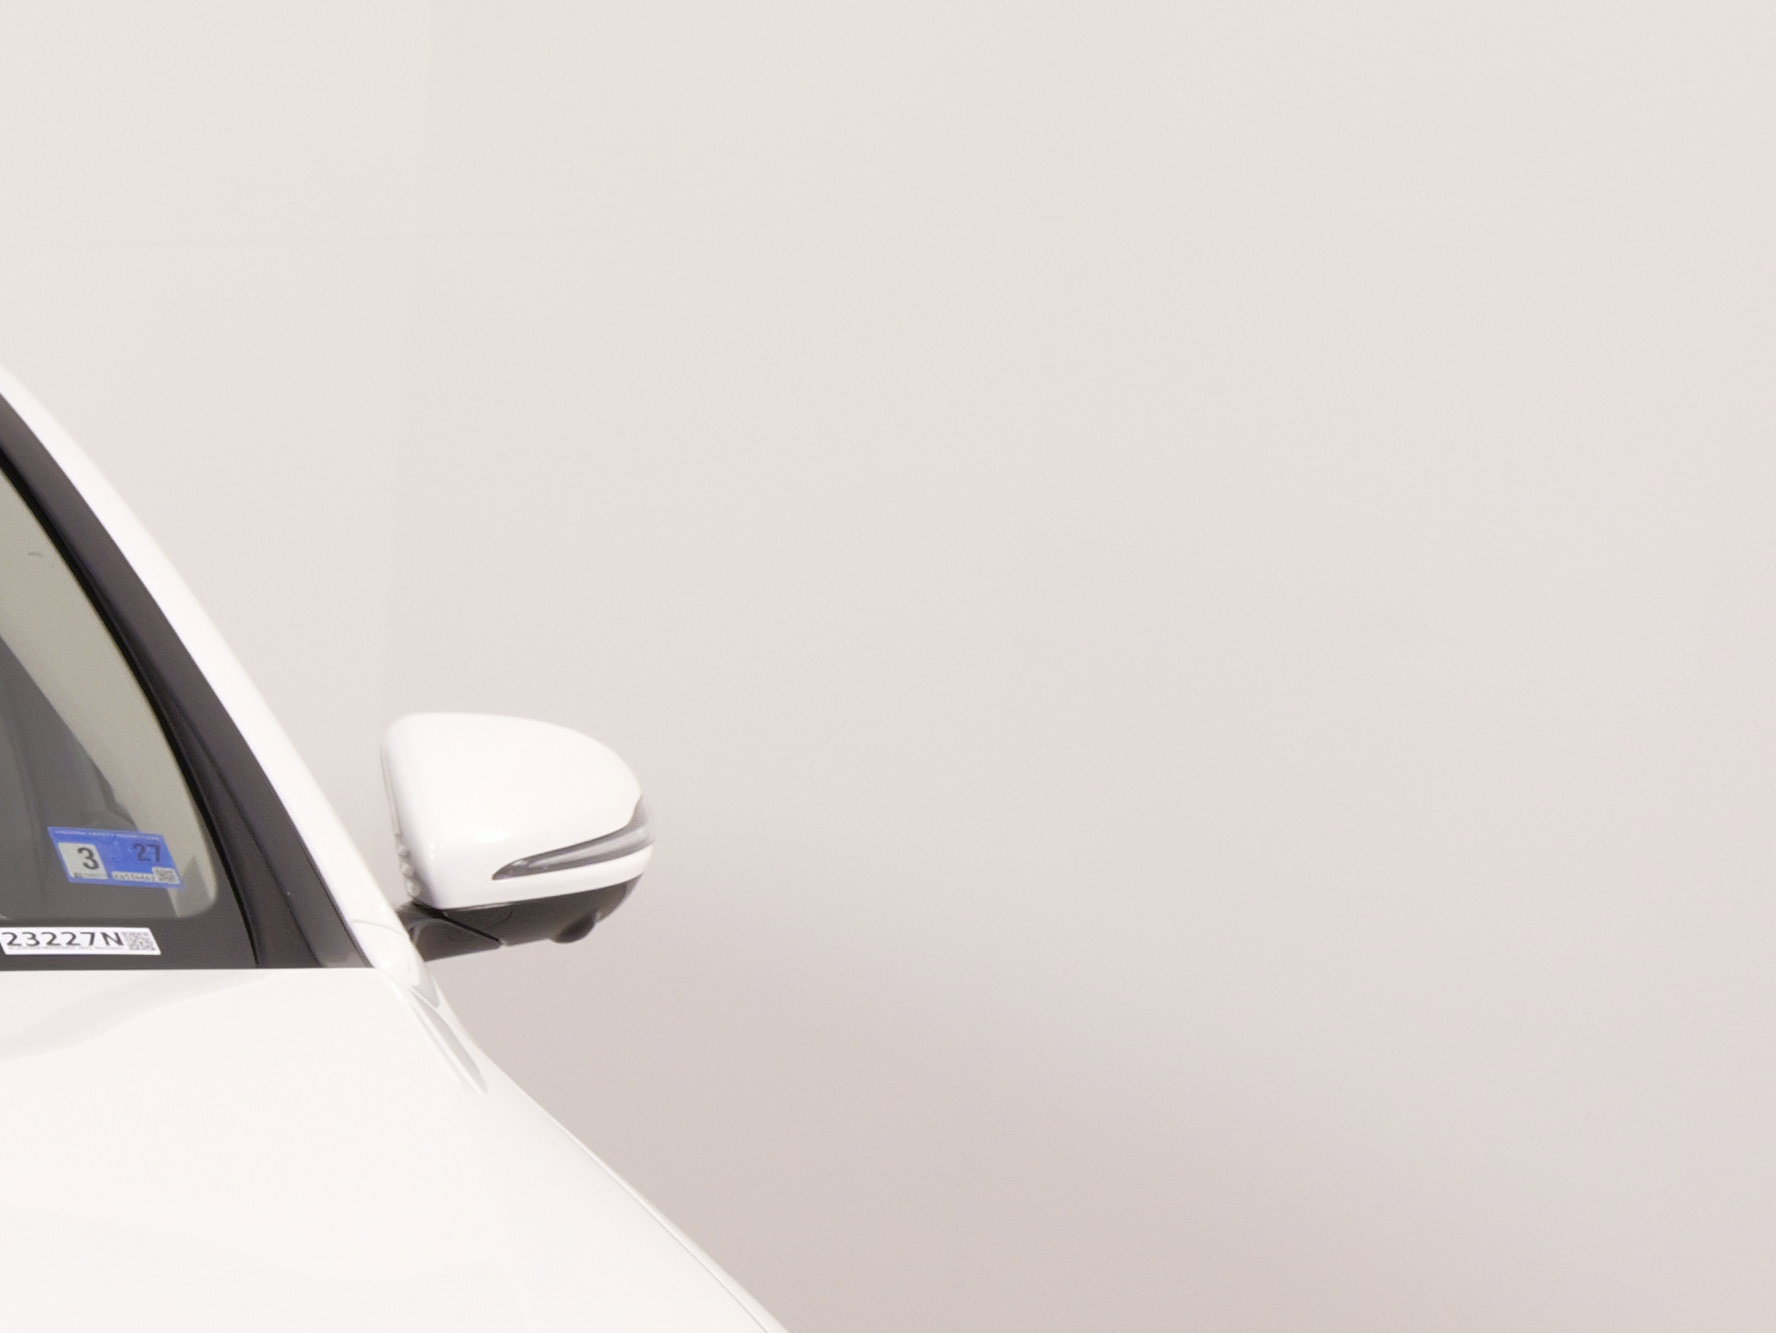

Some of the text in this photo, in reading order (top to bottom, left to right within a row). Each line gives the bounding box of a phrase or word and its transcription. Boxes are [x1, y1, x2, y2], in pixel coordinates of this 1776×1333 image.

[77, 847, 99, 870] 3
[132, 843, 161, 863] 27
[1, 932, 124, 947] 23227N
